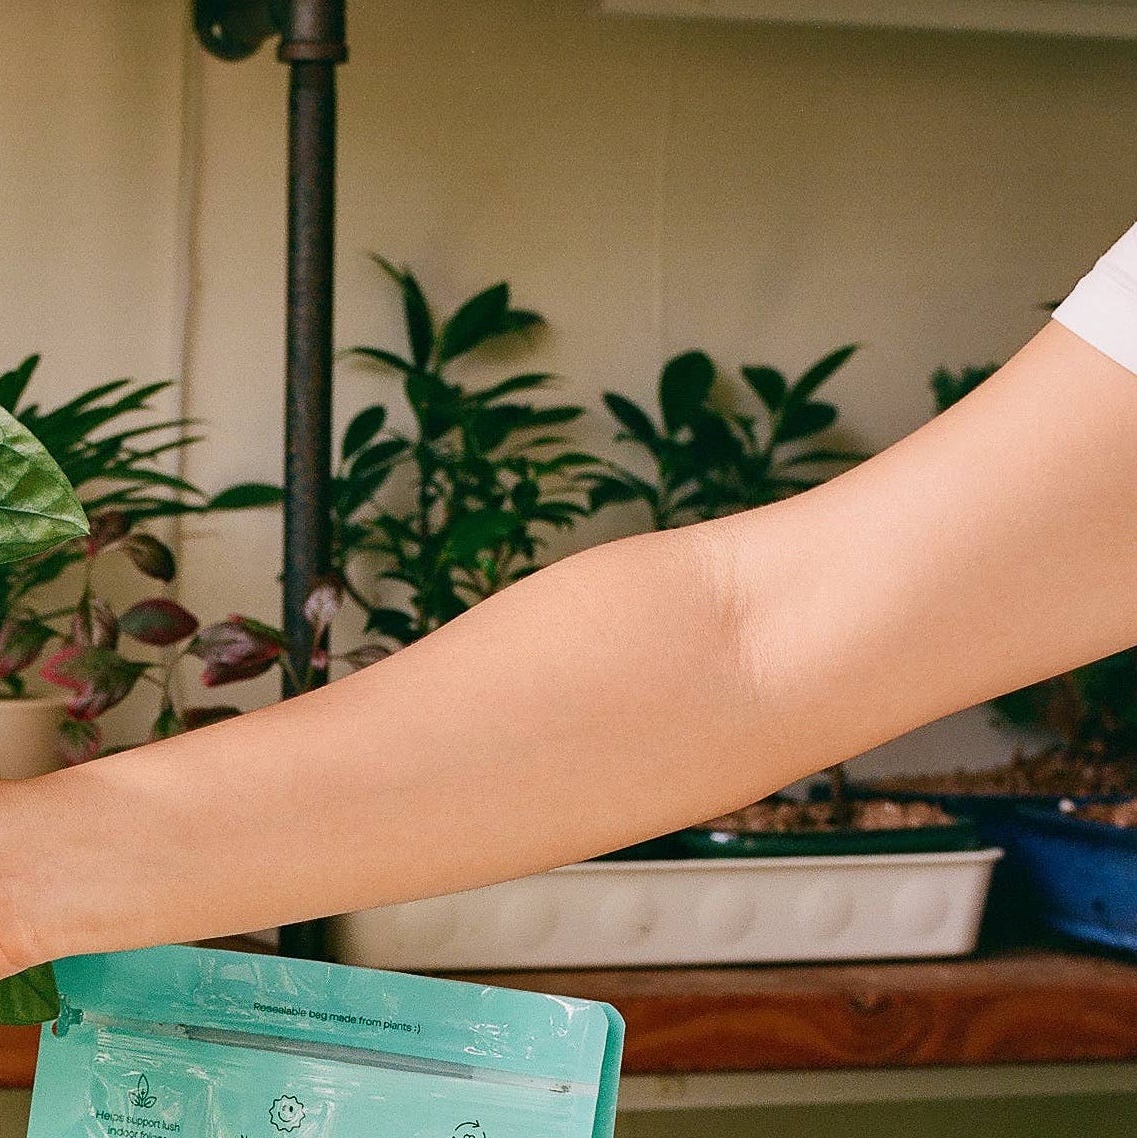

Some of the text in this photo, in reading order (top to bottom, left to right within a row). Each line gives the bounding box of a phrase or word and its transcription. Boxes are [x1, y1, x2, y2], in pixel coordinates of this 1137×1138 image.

[253, 1002, 307, 1017] Resealable
[309, 1010, 327, 1021] bag
[329, 1013, 356, 1024] made
[359, 1016, 382, 1027] from
[383, 1020, 412, 1032] plants
[95, 1110, 180, 1132] Helps support lush
[107, 1125, 138, 1138] indoor
